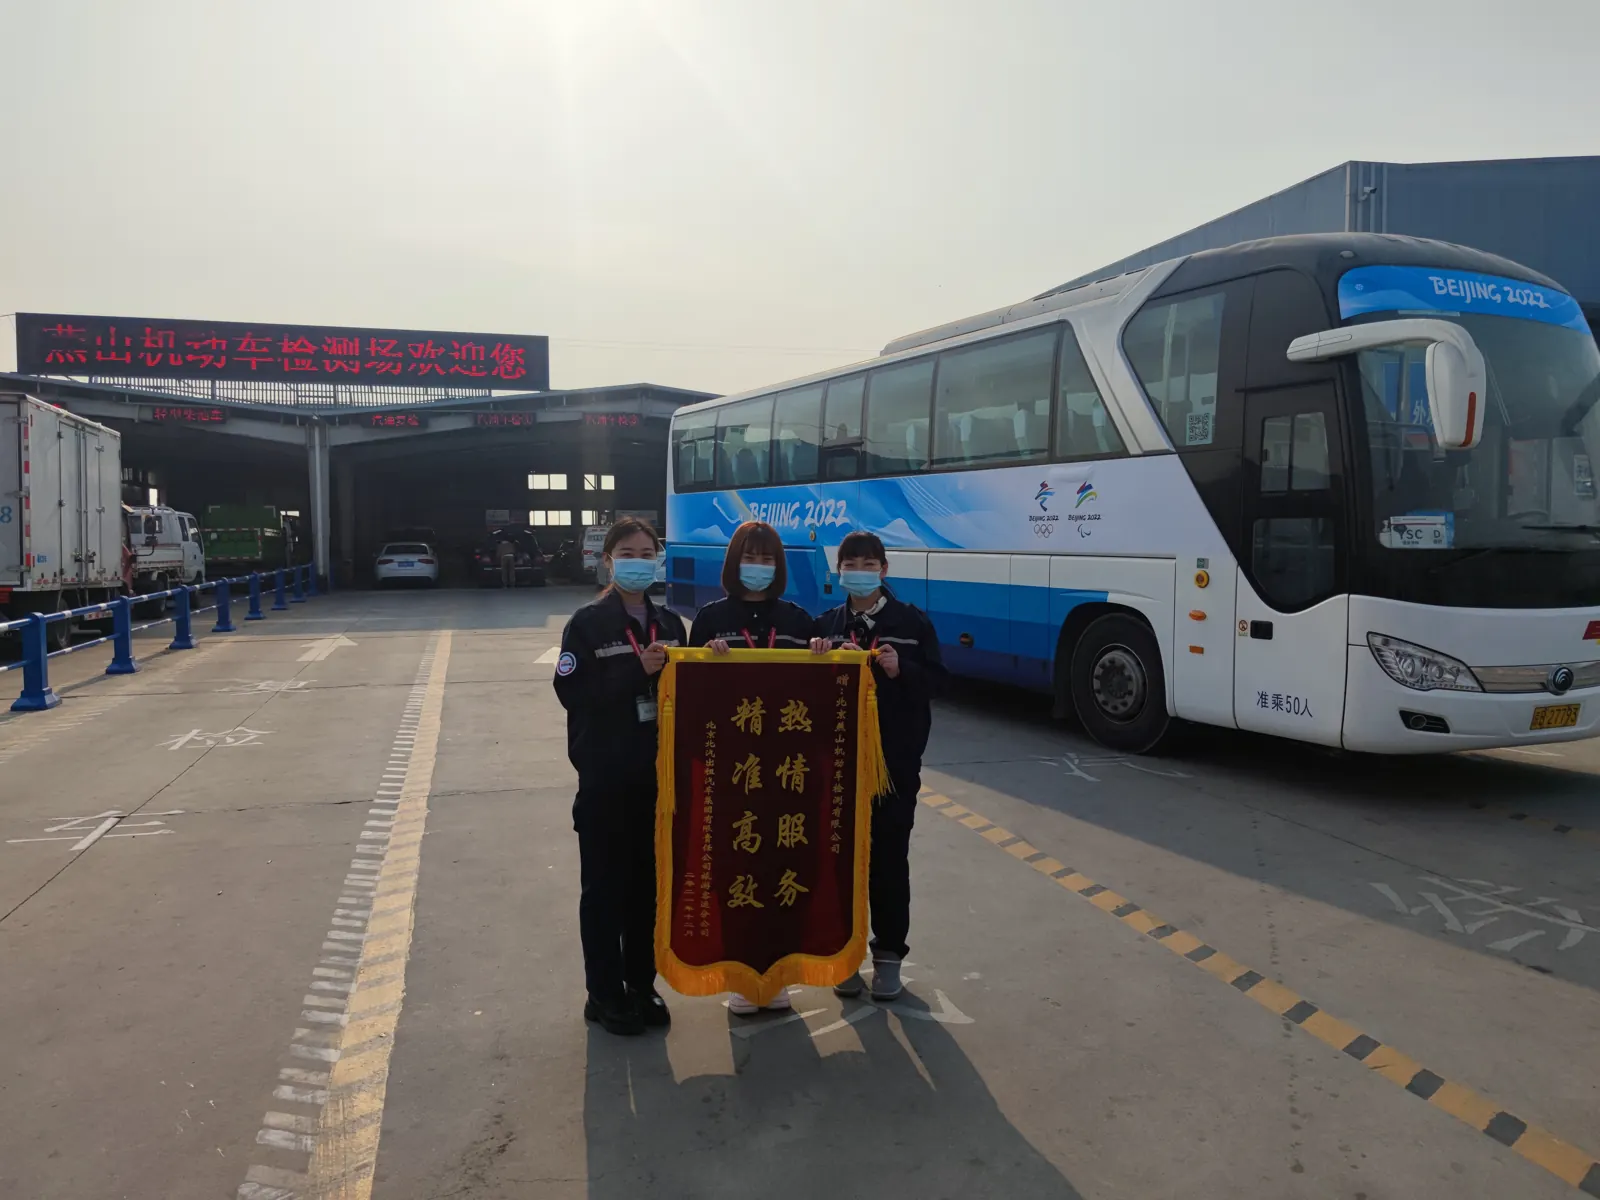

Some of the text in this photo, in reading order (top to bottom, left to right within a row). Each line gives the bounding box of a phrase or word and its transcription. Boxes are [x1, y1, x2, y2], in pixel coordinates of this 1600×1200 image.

[1428, 276, 1551, 308] BEIJING 2022
[43, 323, 527, 380] 燕山机动车检测场欢迎您
[749, 499, 849, 530] BEIJING 2022
[1068, 514, 1086, 522] BEIJING
[1256, 690, 1313, 718] 准乘50人
[727, 696, 767, 908] 精准高效
[773, 699, 813, 907] 热情服务
